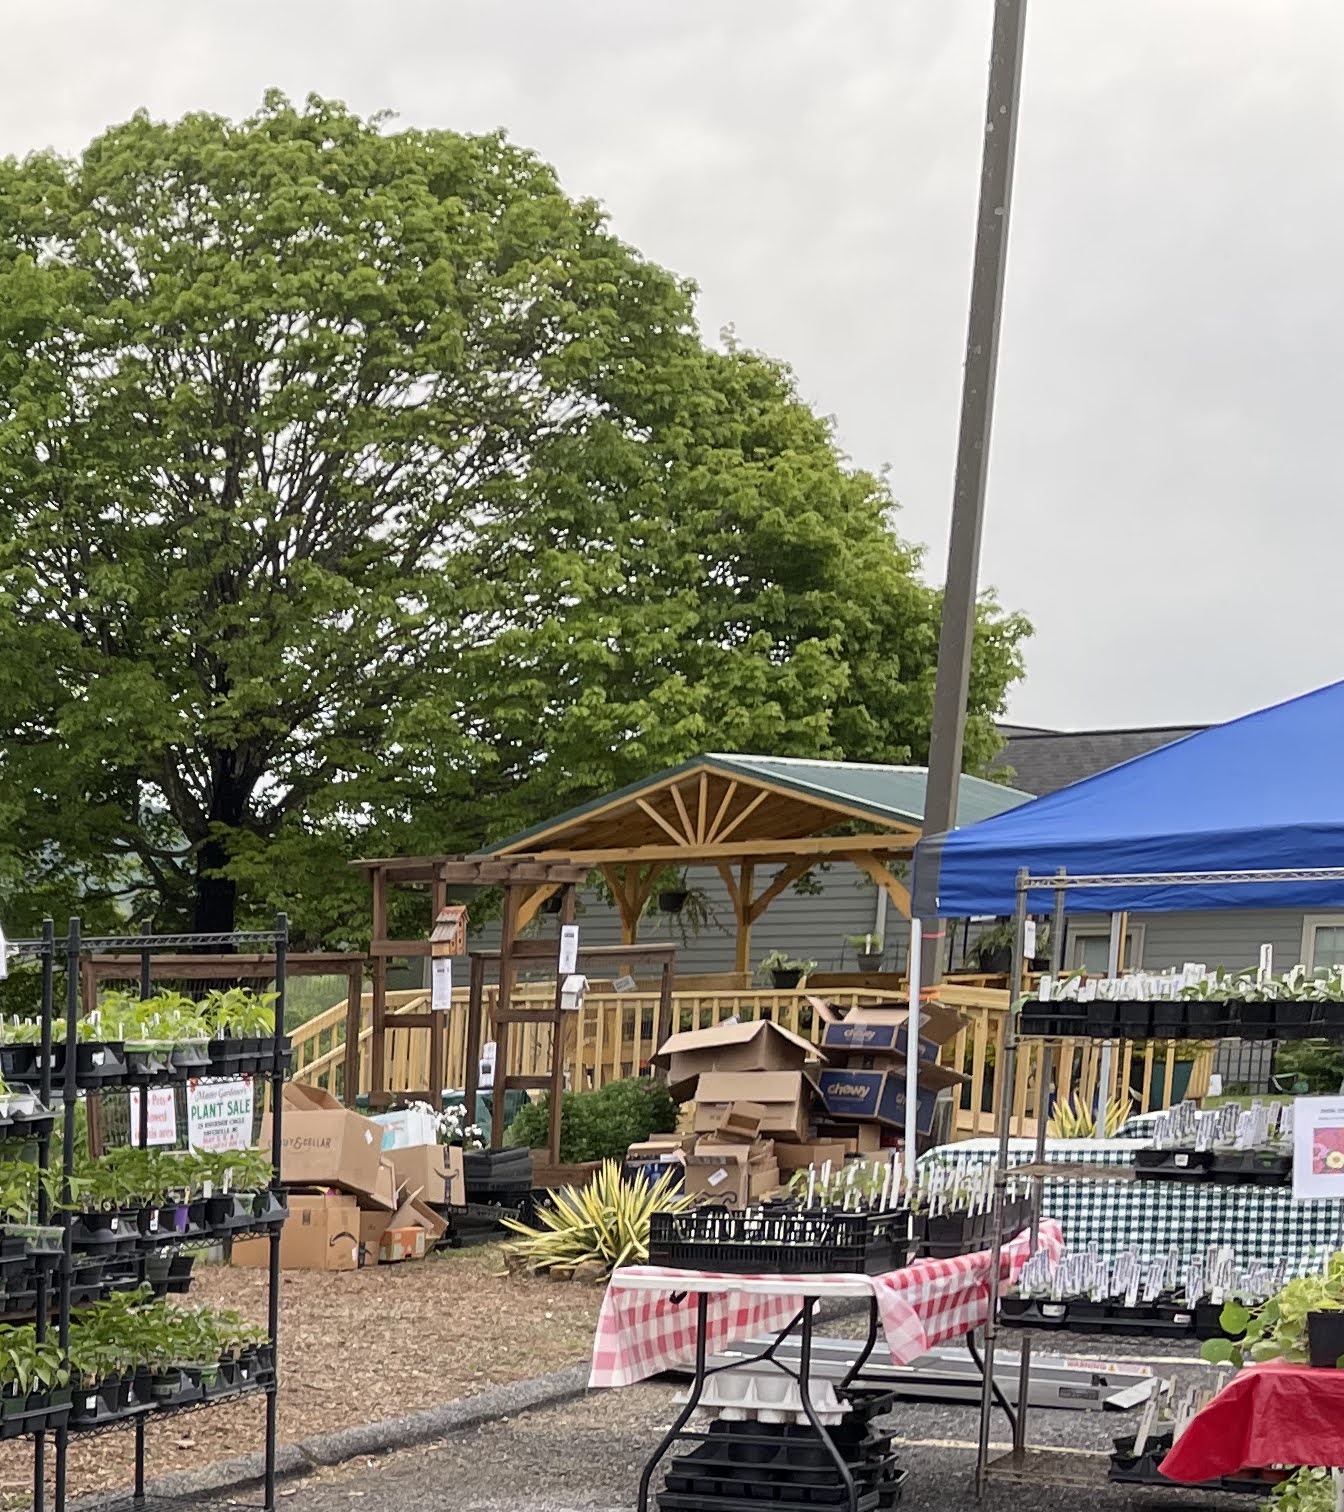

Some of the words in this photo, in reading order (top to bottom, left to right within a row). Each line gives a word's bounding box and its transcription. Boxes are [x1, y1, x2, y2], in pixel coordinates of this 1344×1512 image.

[827, 1082, 871, 1099] chewy
[191, 1102, 224, 1121] PLANT
[227, 1098, 251, 1115] SALE
